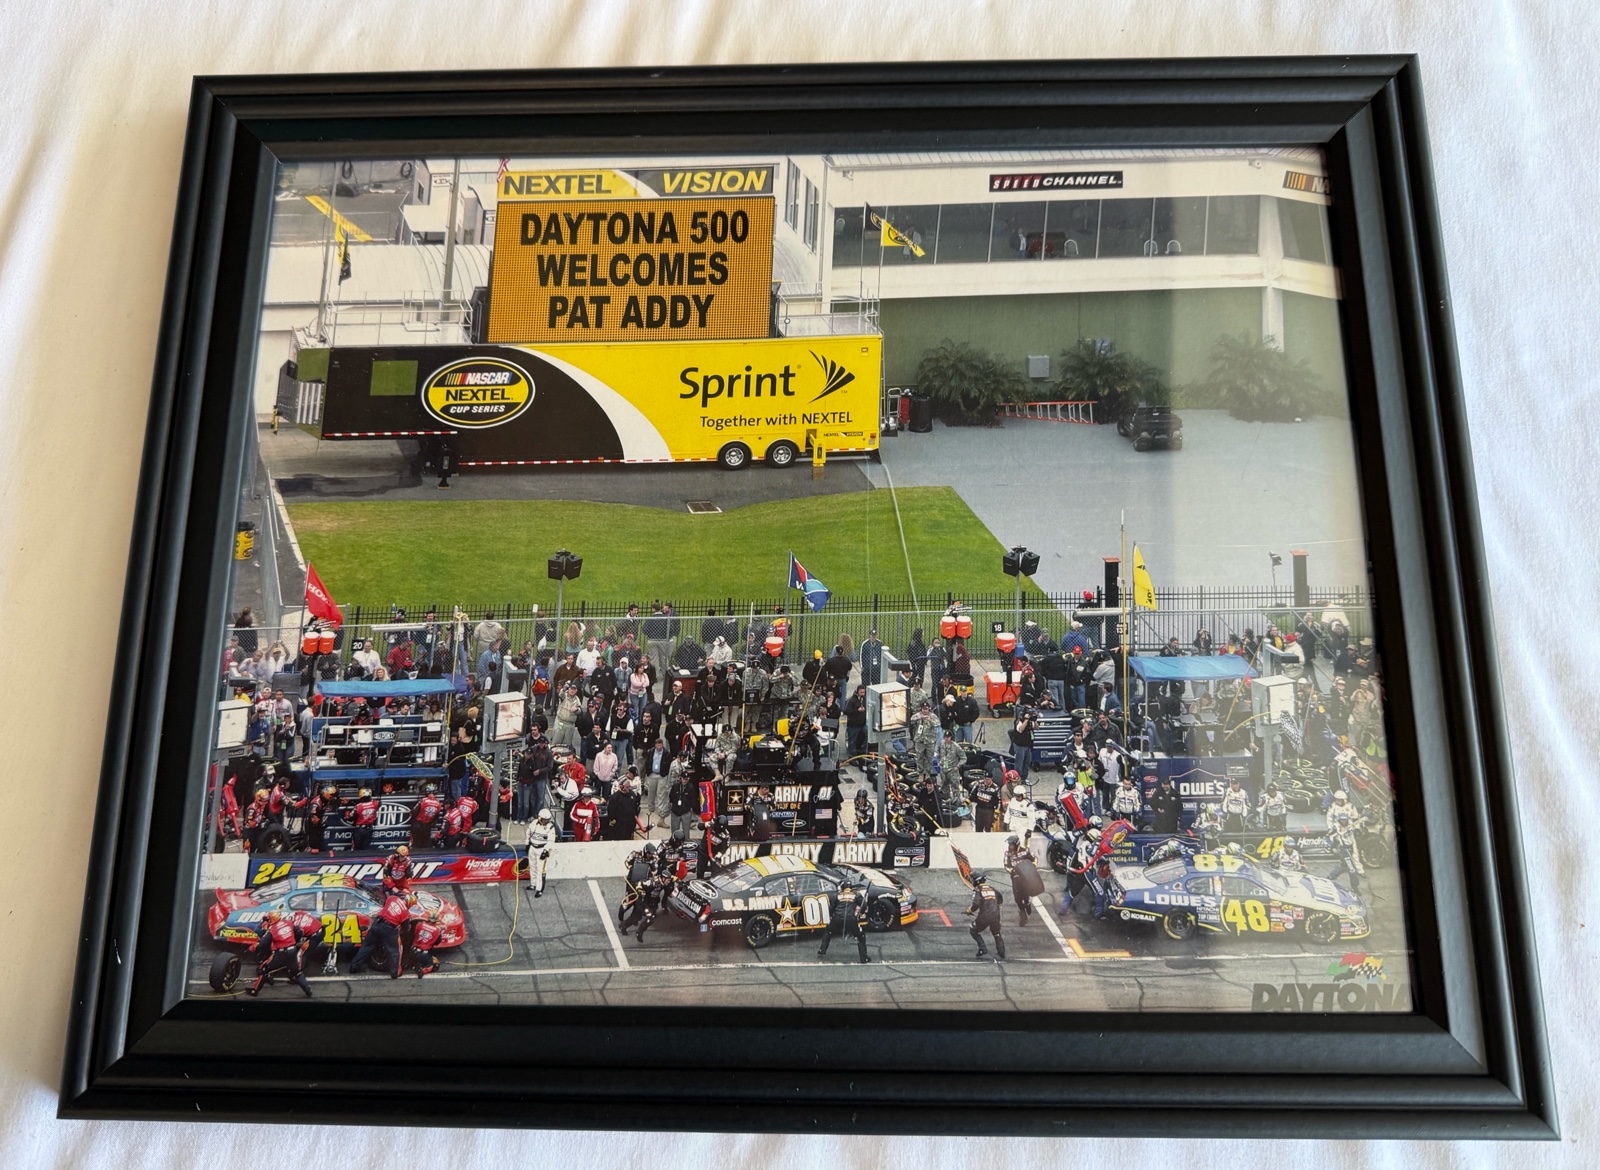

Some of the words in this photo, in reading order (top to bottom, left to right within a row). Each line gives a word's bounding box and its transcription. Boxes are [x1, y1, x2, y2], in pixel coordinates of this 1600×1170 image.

[503, 174, 612, 196] NEXTEL
[663, 170, 767, 194] VISION
[993, 176, 1042, 189] SPEED
[1042, 175, 1118, 187] CHANNEL
[520, 211, 679, 246] DAYTONA
[690, 210, 749, 244] 500
[537, 251, 729, 287] WELCOMES
[548, 295, 611, 329] PAT
[620, 294, 715, 329] ADDY
[465, 371, 511, 385] NASCAR
[679, 364, 796, 408] Sprint
[445, 388, 511, 402] NEXTEL
[449, 406, 470, 414] CUP
[475, 405, 506, 413] SERIES
[700, 414, 762, 431] Together
[765, 413, 797, 426] with
[801, 411, 853, 425] NEXTEL
[994, 623, 1002, 632] 18
[353, 642, 363, 650] 20
[774, 785, 813, 803] ARMY
[720, 843, 761, 865] RMY
[832, 841, 888, 864] ARMY
[252, 862, 293, 885] 24
[317, 861, 443, 881] DUPNT
[465, 858, 504, 871] Hendrick
[722, 898, 748, 912] U.S.
[748, 895, 783, 911] ARMY
[1143, 891, 1217, 907] LOWE'S
[803, 895, 831, 926] 01
[1130, 912, 1156, 921] KOBALT
[1225, 899, 1270, 934] 48
[321, 914, 362, 943] 24
[711, 918, 743, 926] comcast
[219, 929, 260, 938] Nicorette
